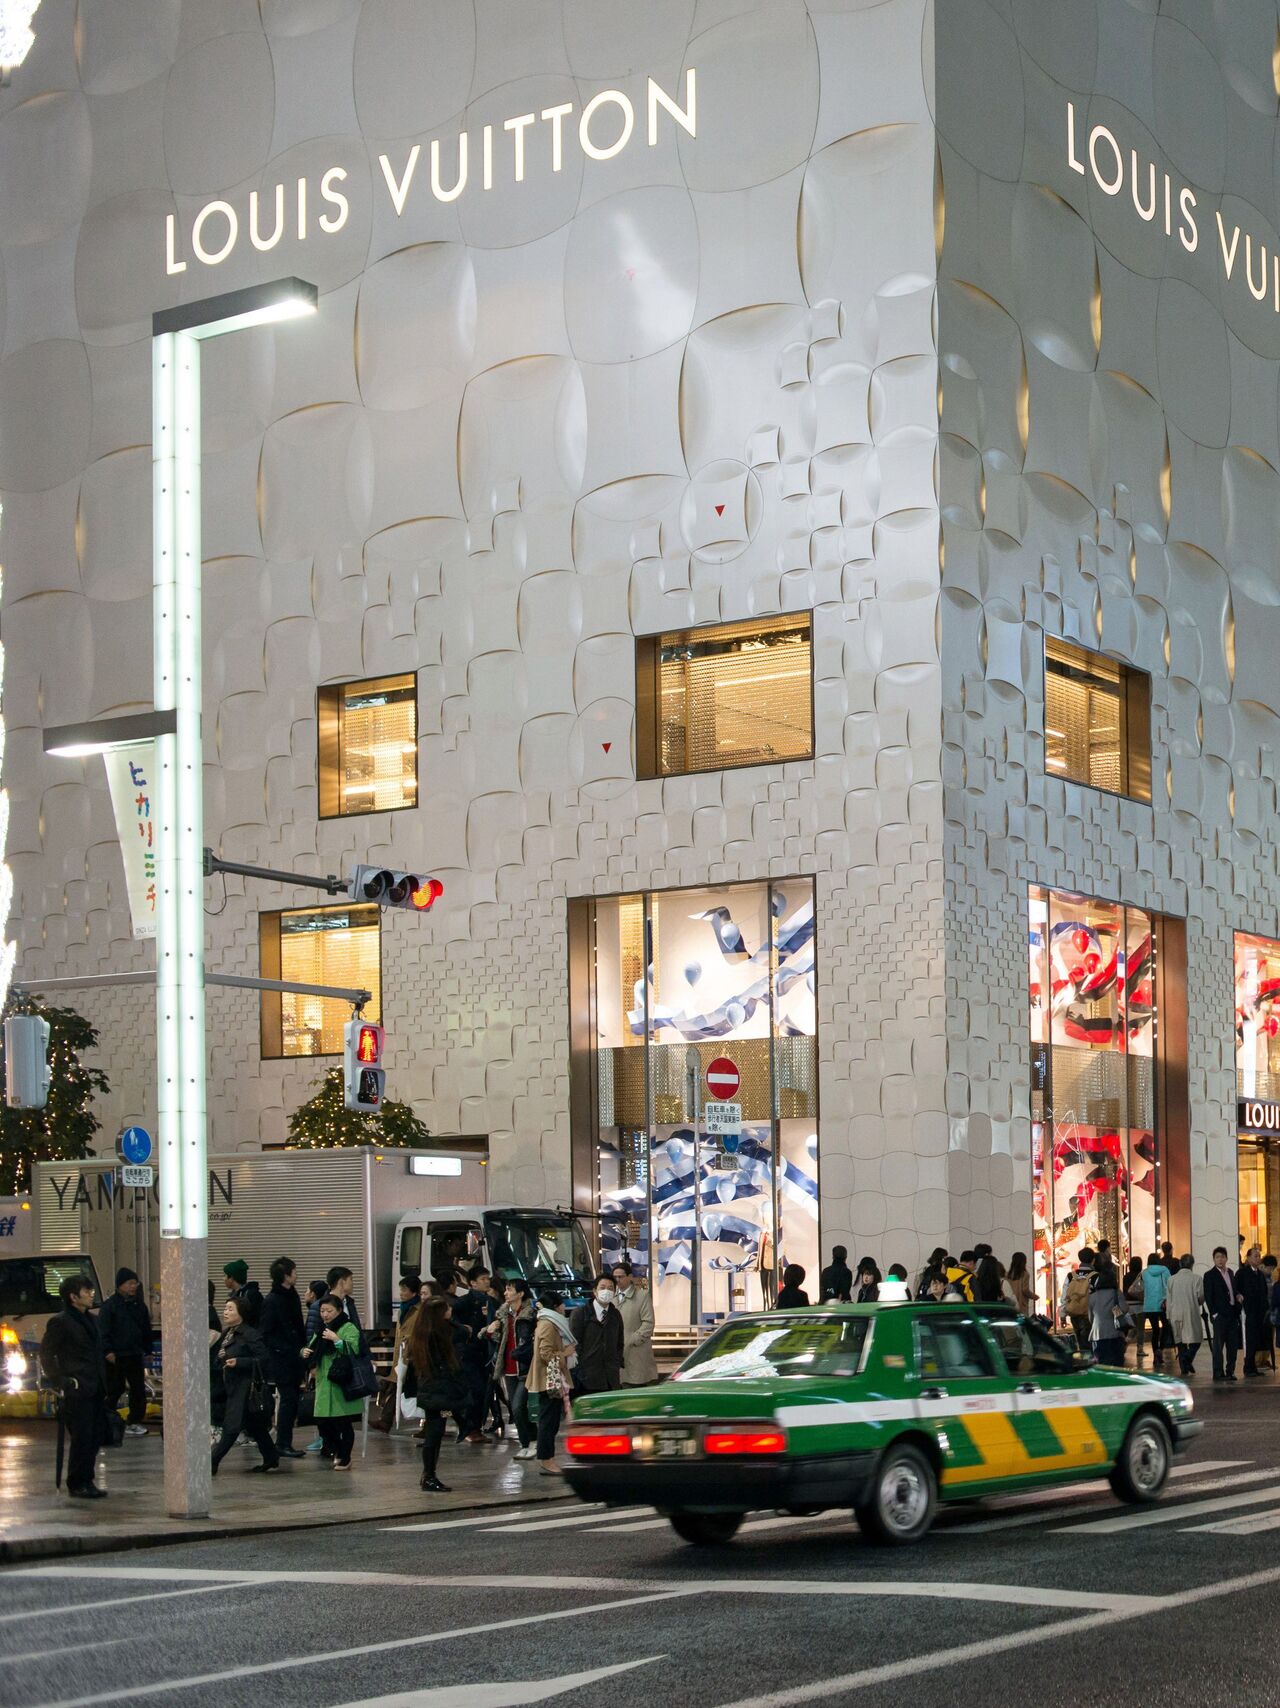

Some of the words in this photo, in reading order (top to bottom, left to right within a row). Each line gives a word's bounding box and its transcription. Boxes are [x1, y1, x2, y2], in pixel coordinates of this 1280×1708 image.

[165, 166, 350, 275] LOUIS
[379, 68, 698, 218] VUITTON
[1067, 102, 1199, 253] LOUIS
[128, 760, 157, 912] ヒカリミチ
[125, 1176, 150, 1185] ここから
